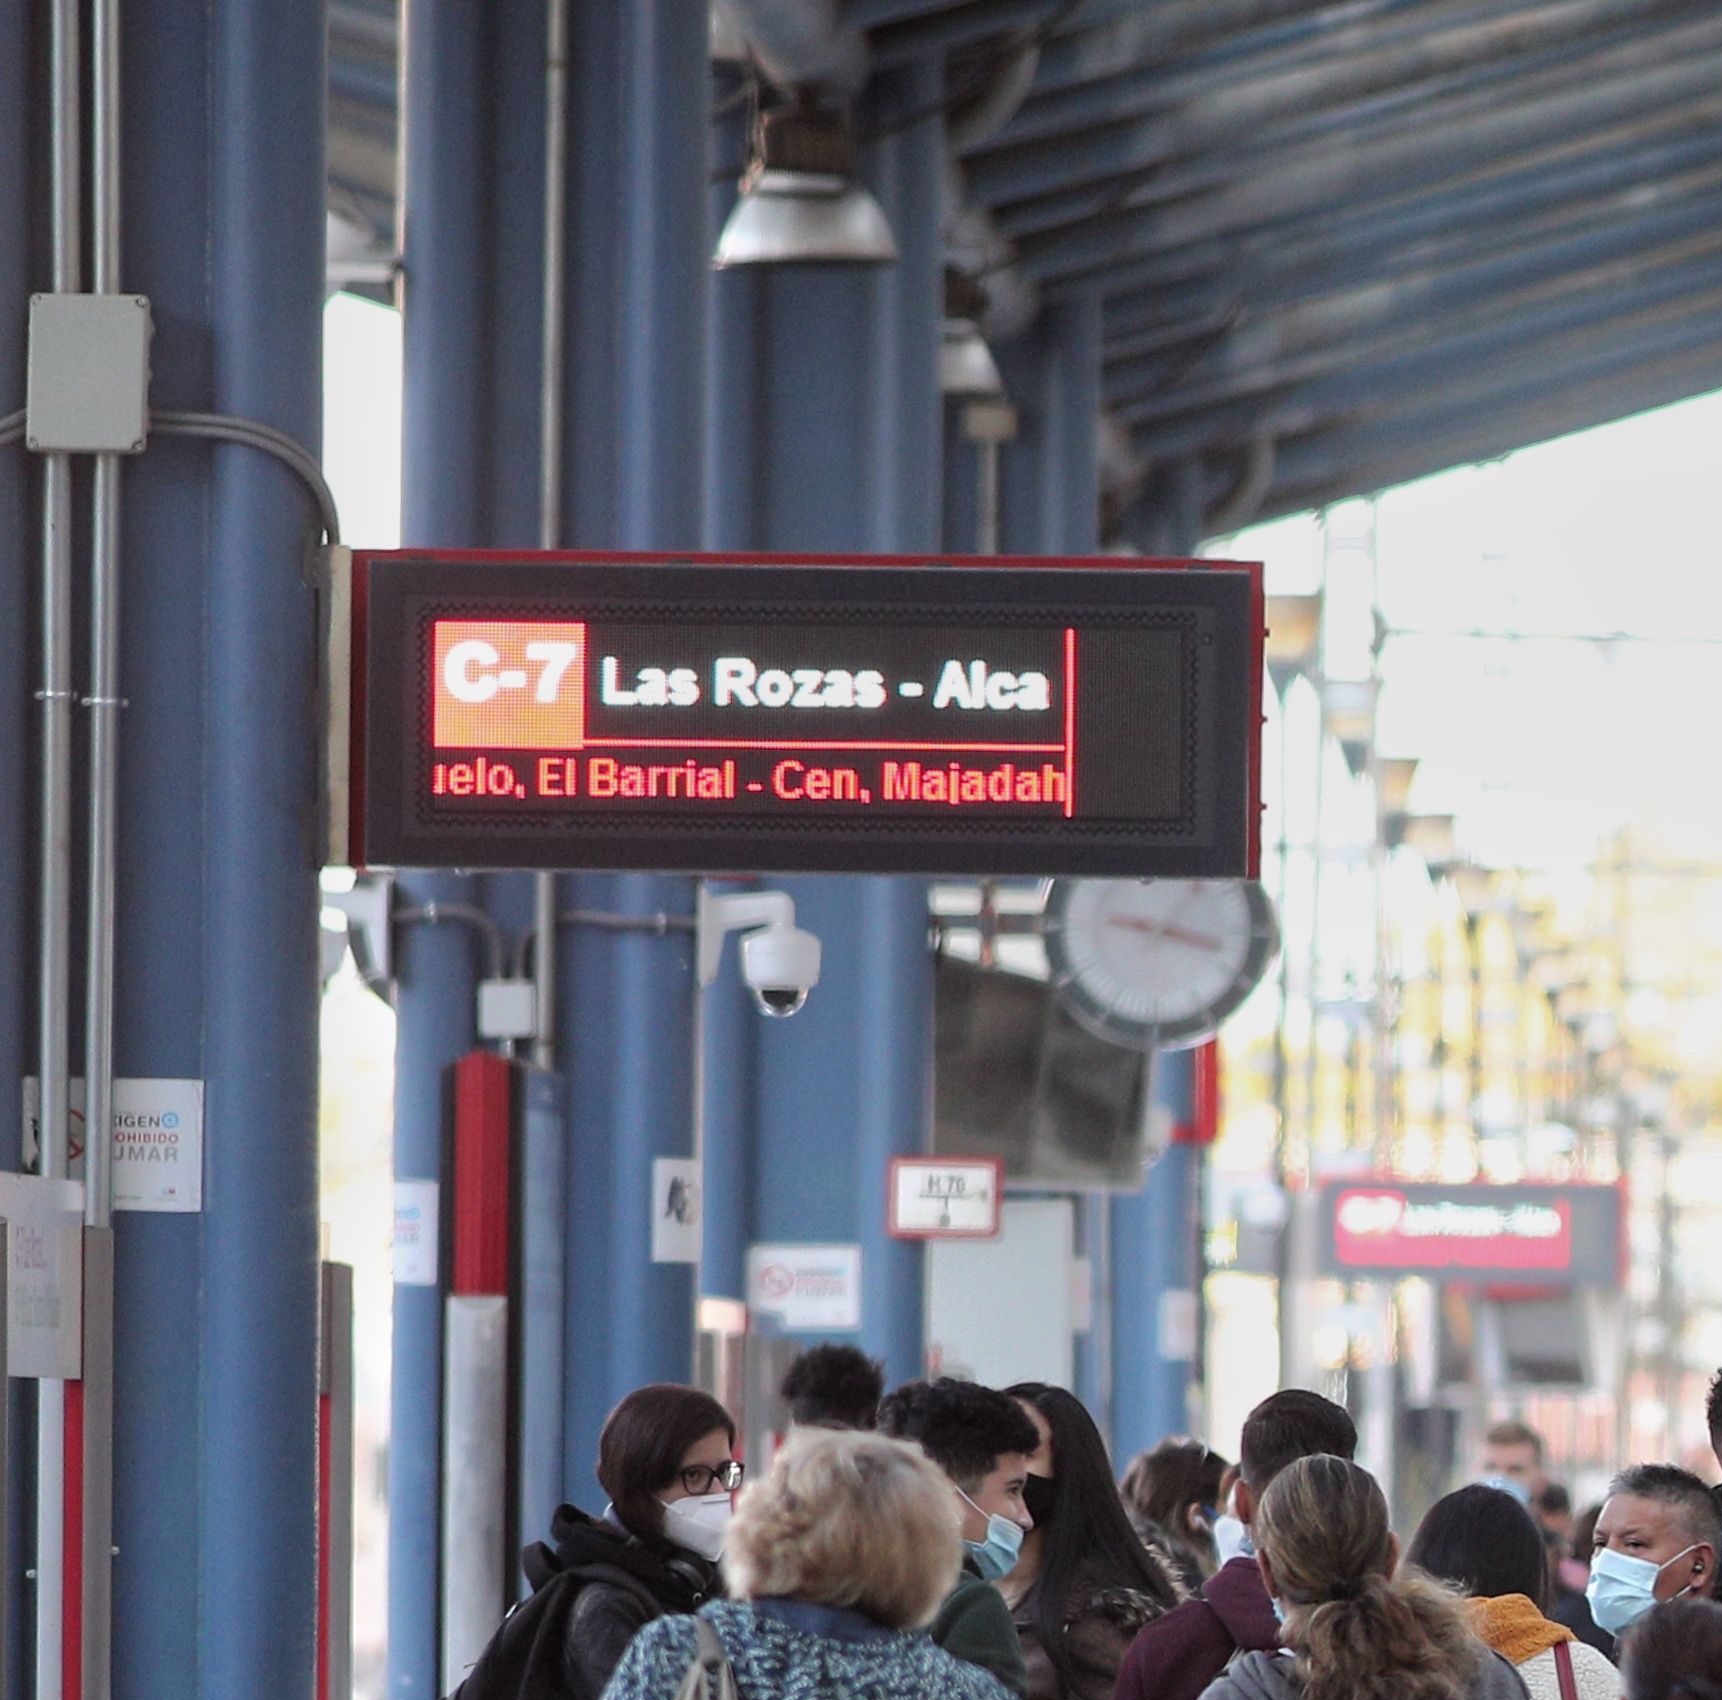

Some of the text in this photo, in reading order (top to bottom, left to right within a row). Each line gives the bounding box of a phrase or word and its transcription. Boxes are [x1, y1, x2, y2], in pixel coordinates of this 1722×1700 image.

[444, 640, 577, 703] C-7
[601, 656, 700, 706] Las
[714, 657, 887, 708] Rozas
[933, 659, 1051, 710] Alca
[538, 756, 579, 797] El
[588, 756, 736, 799] Barrial
[112, 1146, 179, 1163] UMAR
[113, 1131, 179, 1145] OHIBIDO
